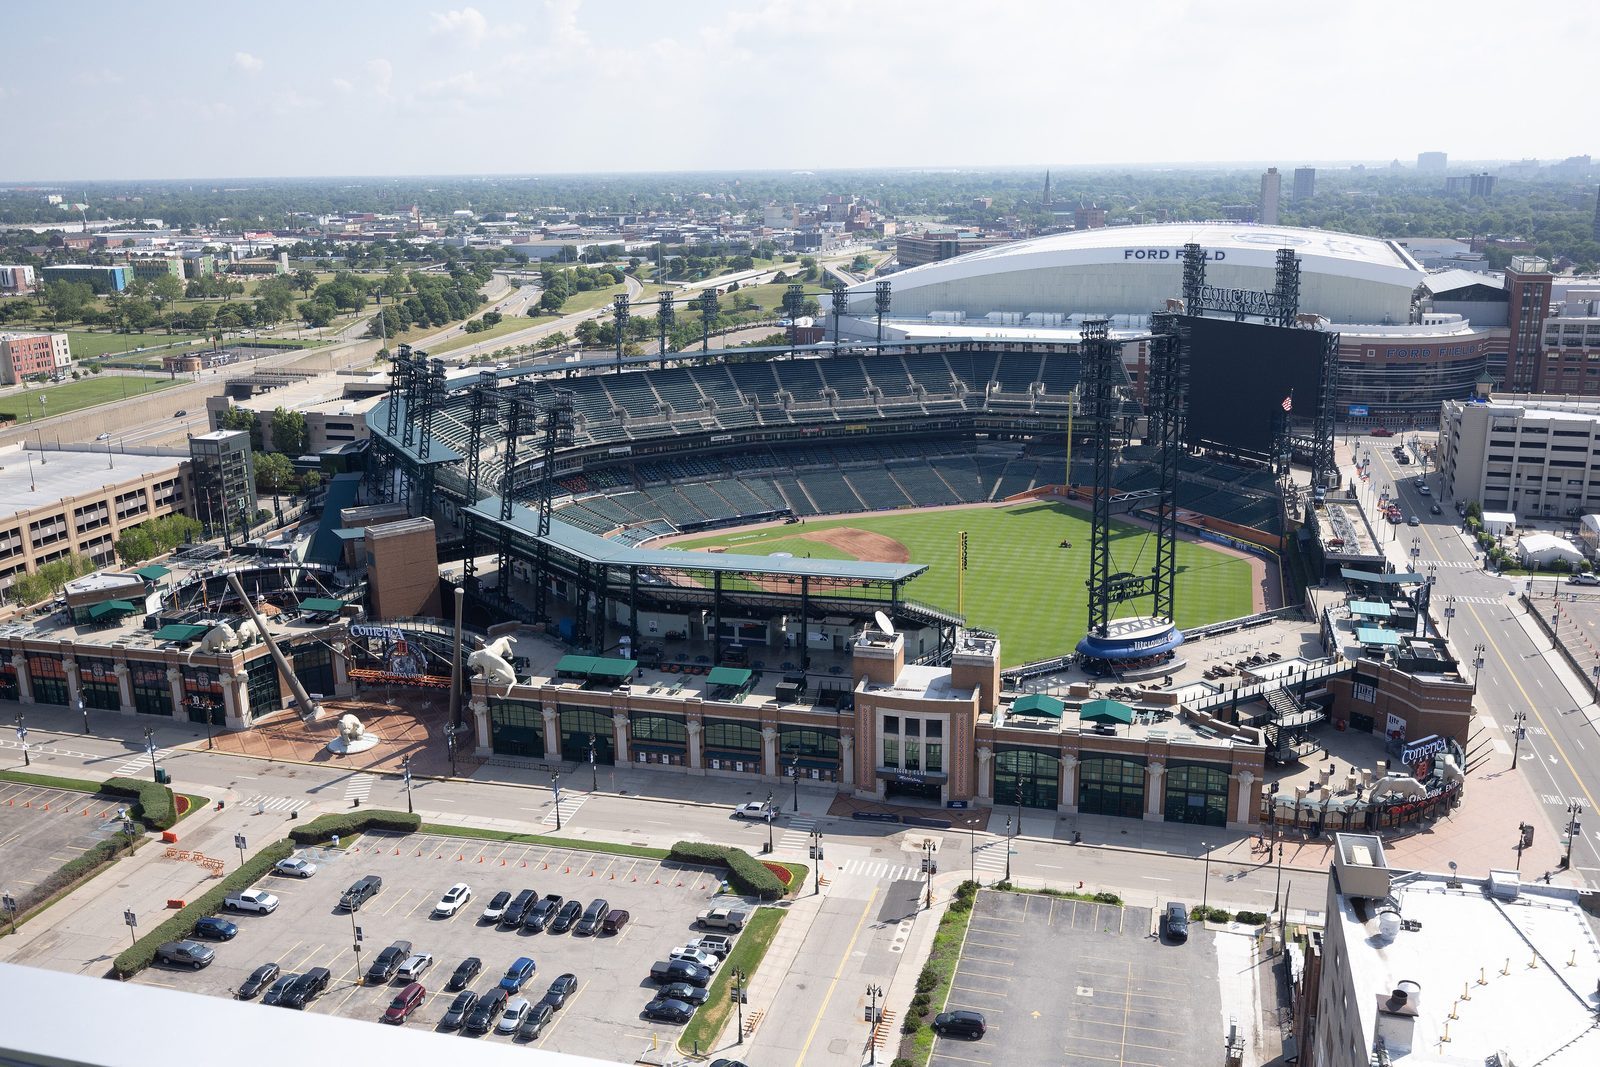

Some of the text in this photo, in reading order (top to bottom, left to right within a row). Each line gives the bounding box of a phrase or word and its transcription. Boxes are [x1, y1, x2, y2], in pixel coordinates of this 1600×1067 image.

[1124, 249, 1226, 261] FORD FLD
[1386, 345, 1475, 359] FORD FIELD
